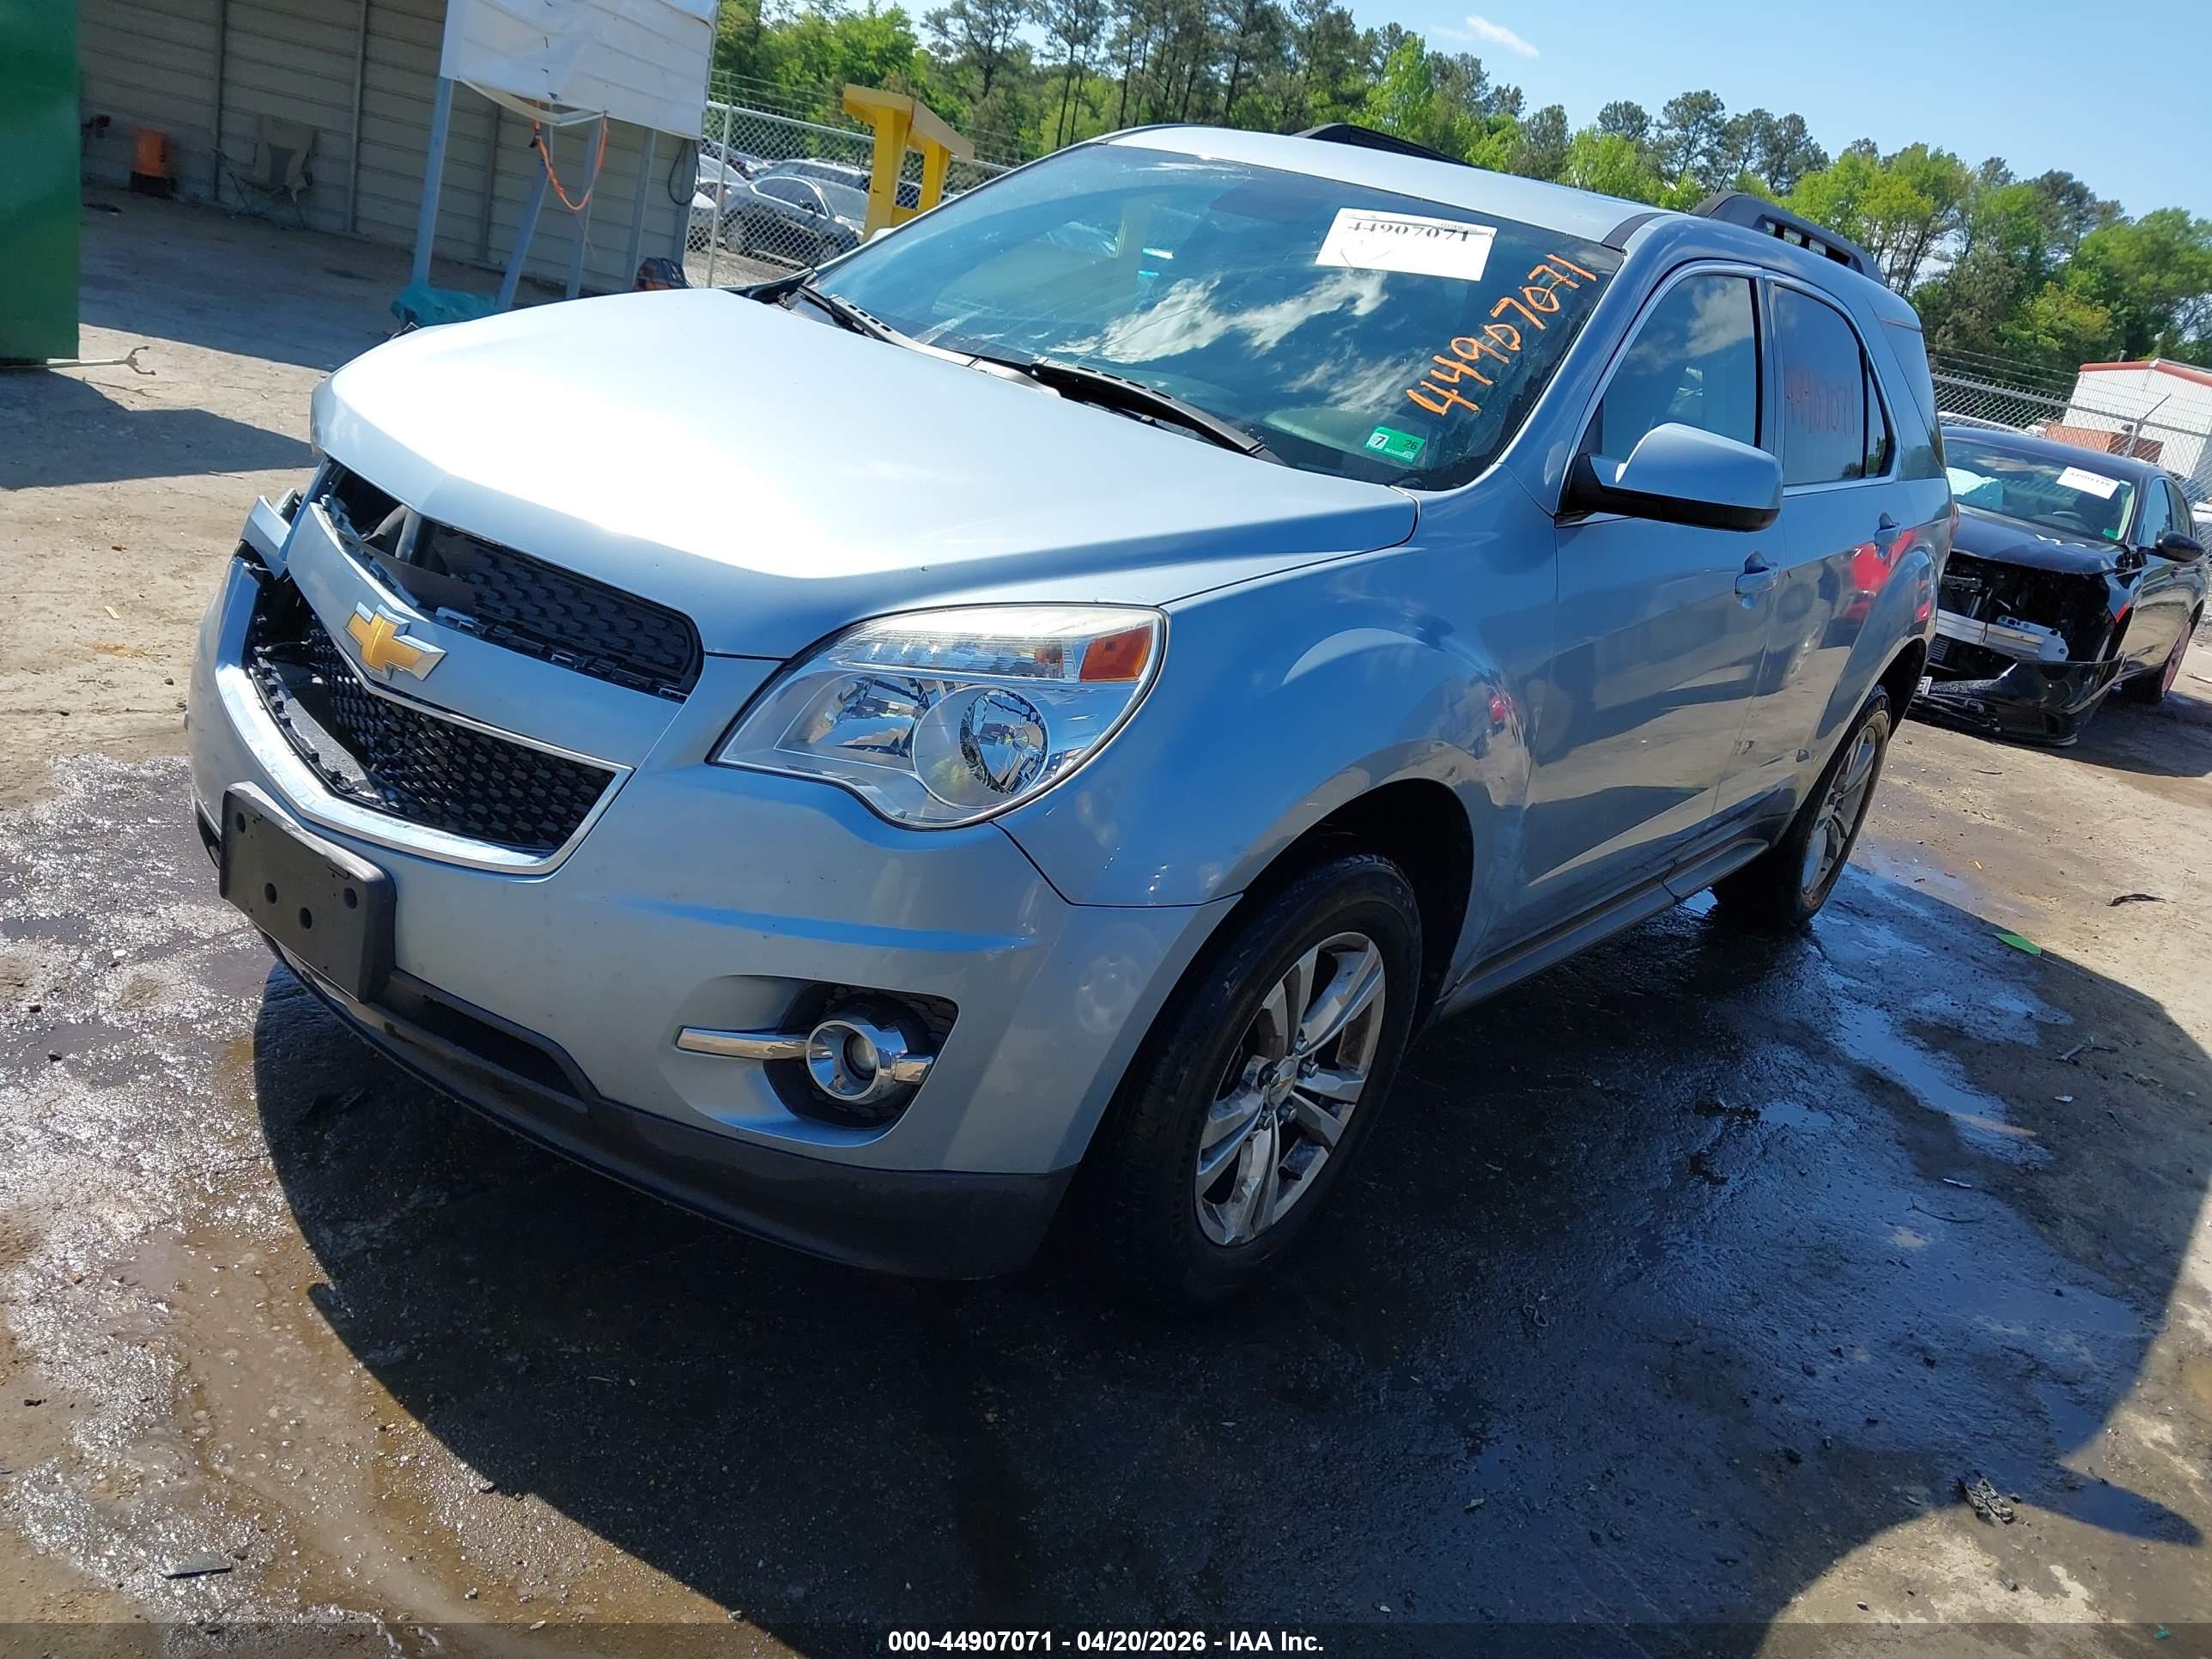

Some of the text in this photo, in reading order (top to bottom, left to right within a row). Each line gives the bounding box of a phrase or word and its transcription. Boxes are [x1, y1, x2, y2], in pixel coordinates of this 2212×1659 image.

[1406, 254, 1598, 416] 44907071
[1376, 434, 1419, 451] 7 26
